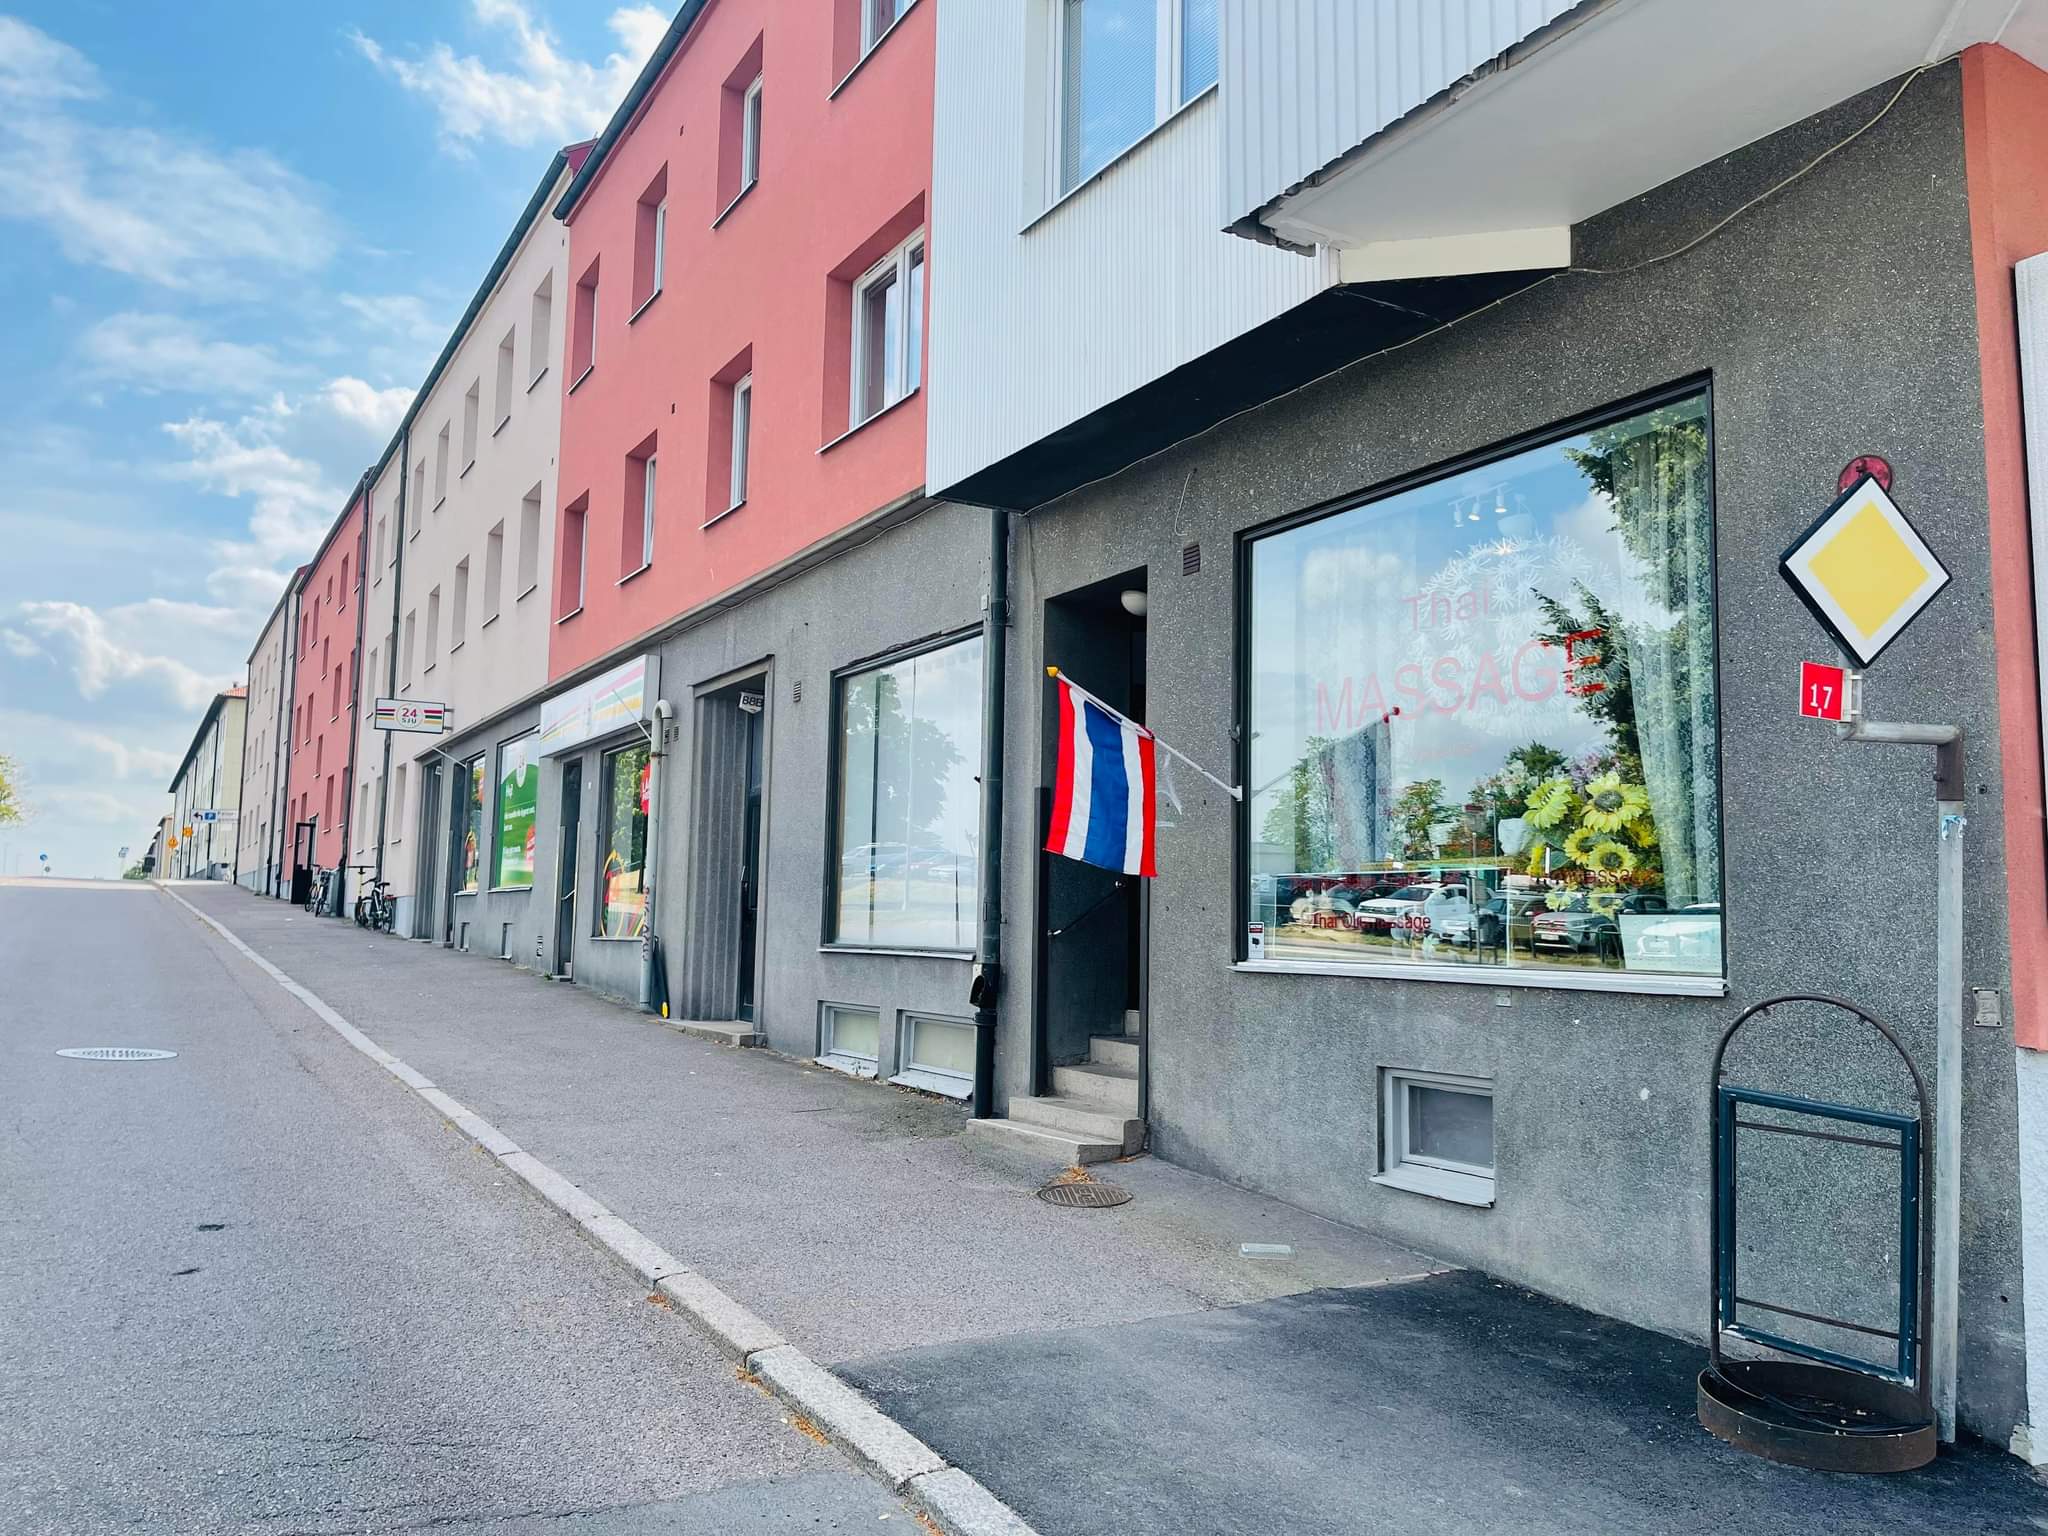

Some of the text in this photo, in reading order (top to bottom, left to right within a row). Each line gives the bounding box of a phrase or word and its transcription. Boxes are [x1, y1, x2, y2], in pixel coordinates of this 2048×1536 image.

[1401, 580, 1490, 630] Thai
[1316, 629, 1608, 733] MASSAGE
[1810, 683, 1833, 710] 17
[401, 707, 417, 718] 24
